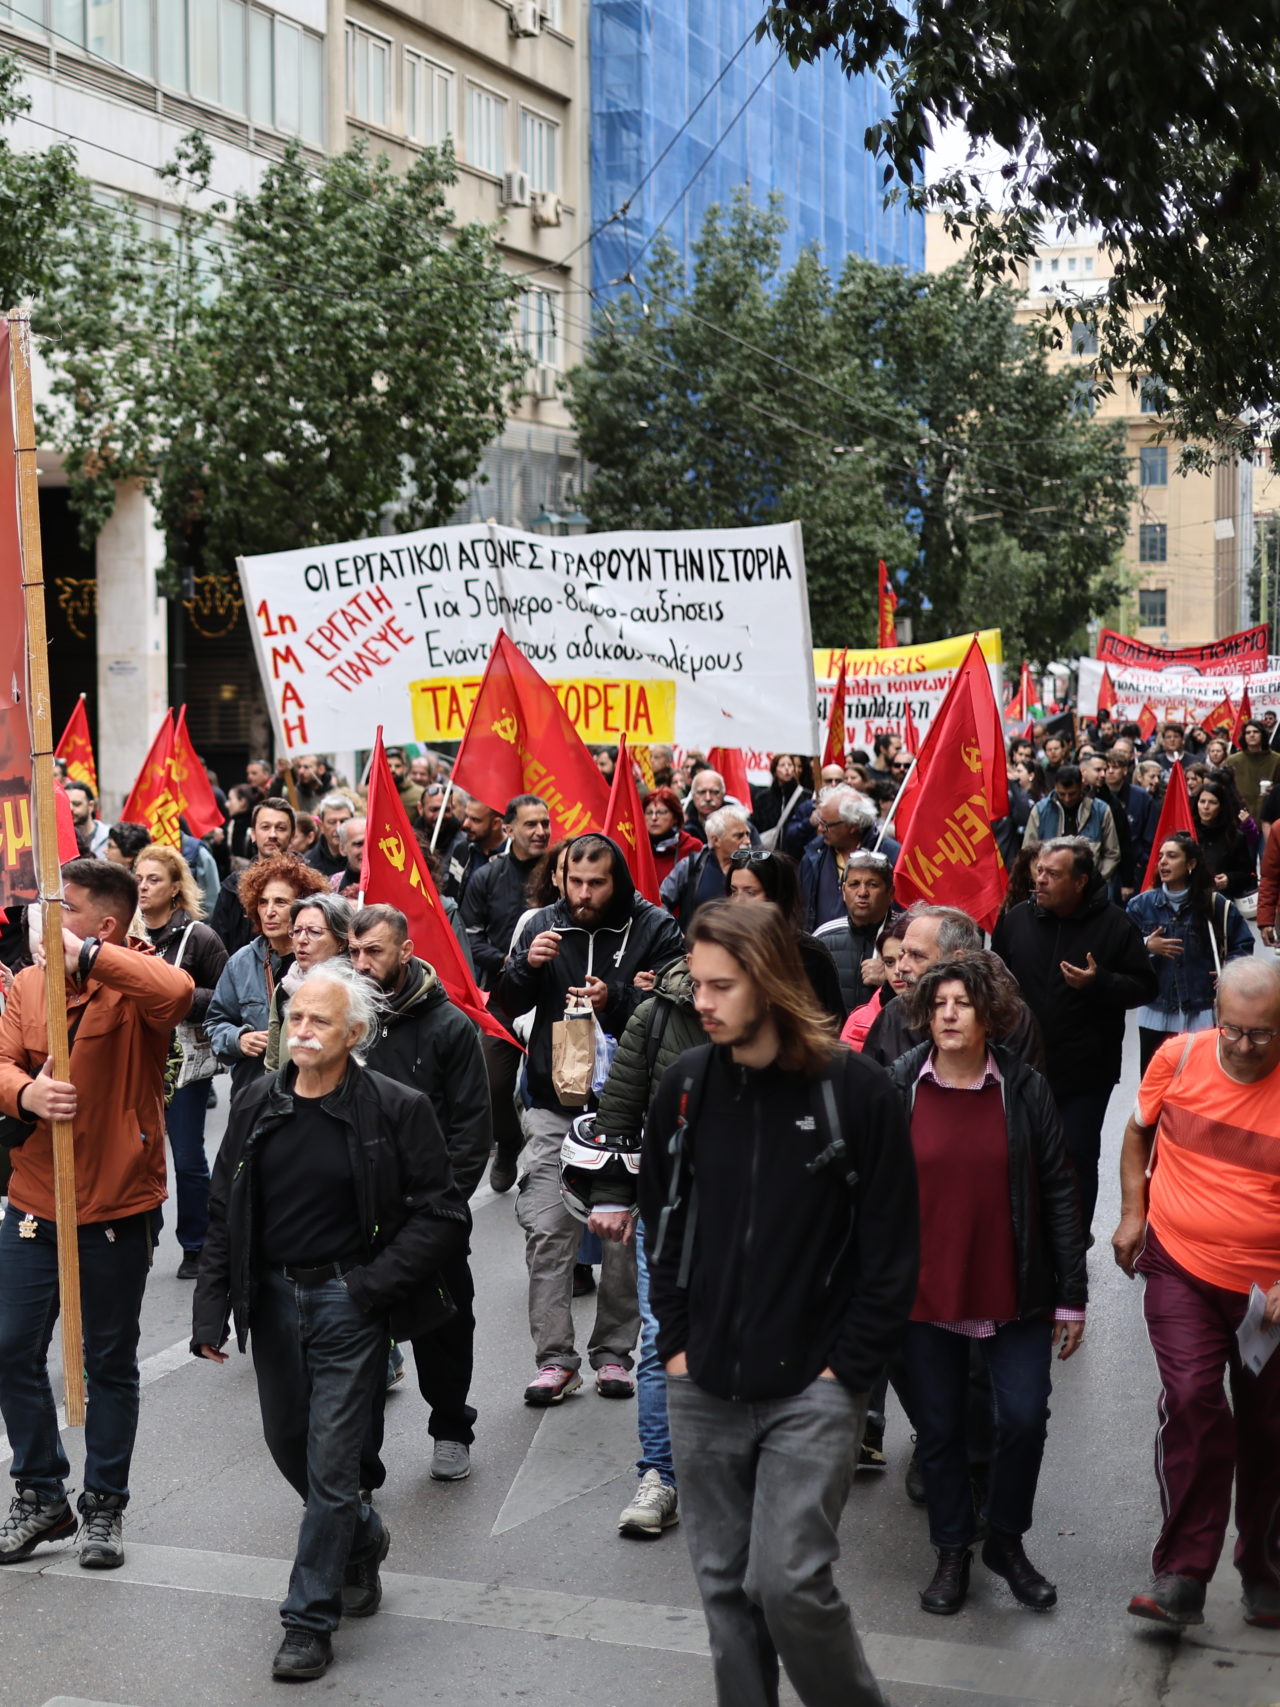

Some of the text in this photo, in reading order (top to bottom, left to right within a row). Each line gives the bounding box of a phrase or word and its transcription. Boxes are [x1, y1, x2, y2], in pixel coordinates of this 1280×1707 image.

[304, 538, 792, 592] ΟΙ ΕΡΓΑΤΙΚΟΙ ΑΓΩΝΕΣ ΓΡΑΦΟΥΝ ΤΗΝ ΙΣΤΟΡΙΑ
[305, 584, 394, 662] ΕΡΓΑΤΗ
[1102, 629, 1267, 662] ΠΟΛΕΜΟ ΠΟΛΕΜΟ
[326, 615, 415, 692] ΠΑΛΕΨΕ
[887, 670, 954, 694] κοινωνί
